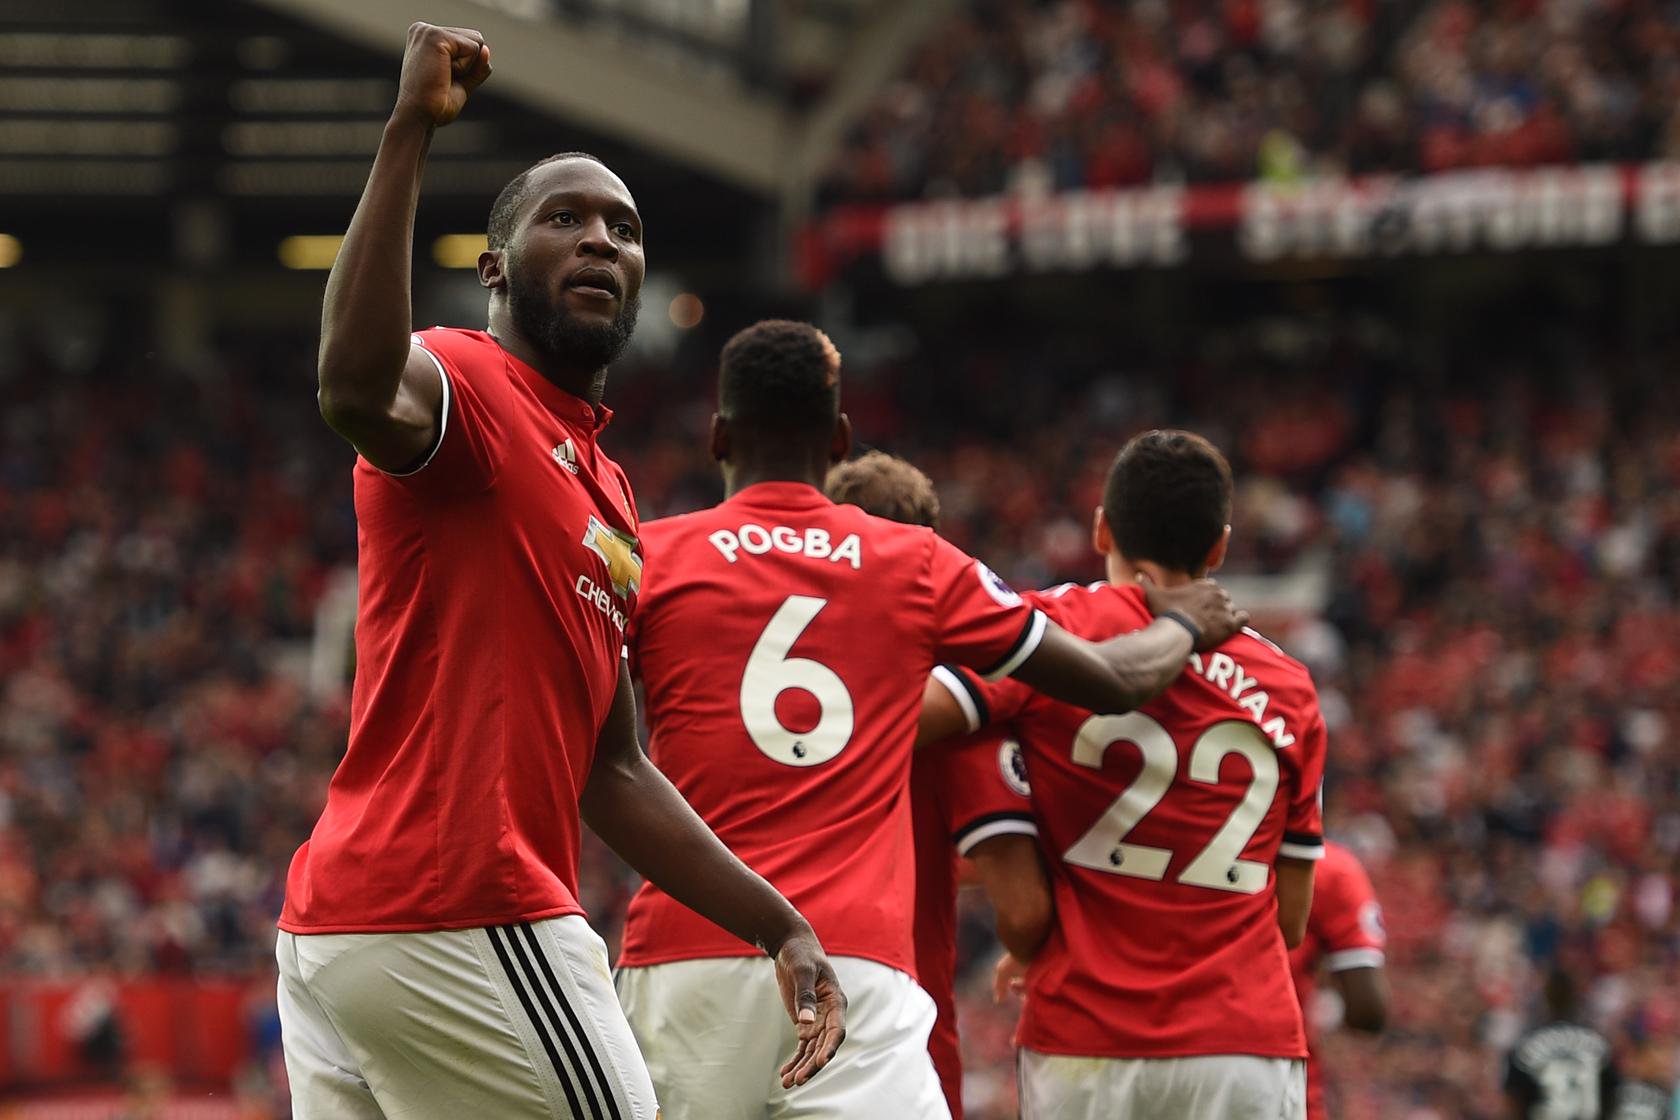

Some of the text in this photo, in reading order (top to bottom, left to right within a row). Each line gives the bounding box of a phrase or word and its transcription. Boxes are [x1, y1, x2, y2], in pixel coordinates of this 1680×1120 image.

[708, 523, 861, 569] POGBA
[739, 594, 855, 767] 6
[1062, 711, 1280, 895] 22
